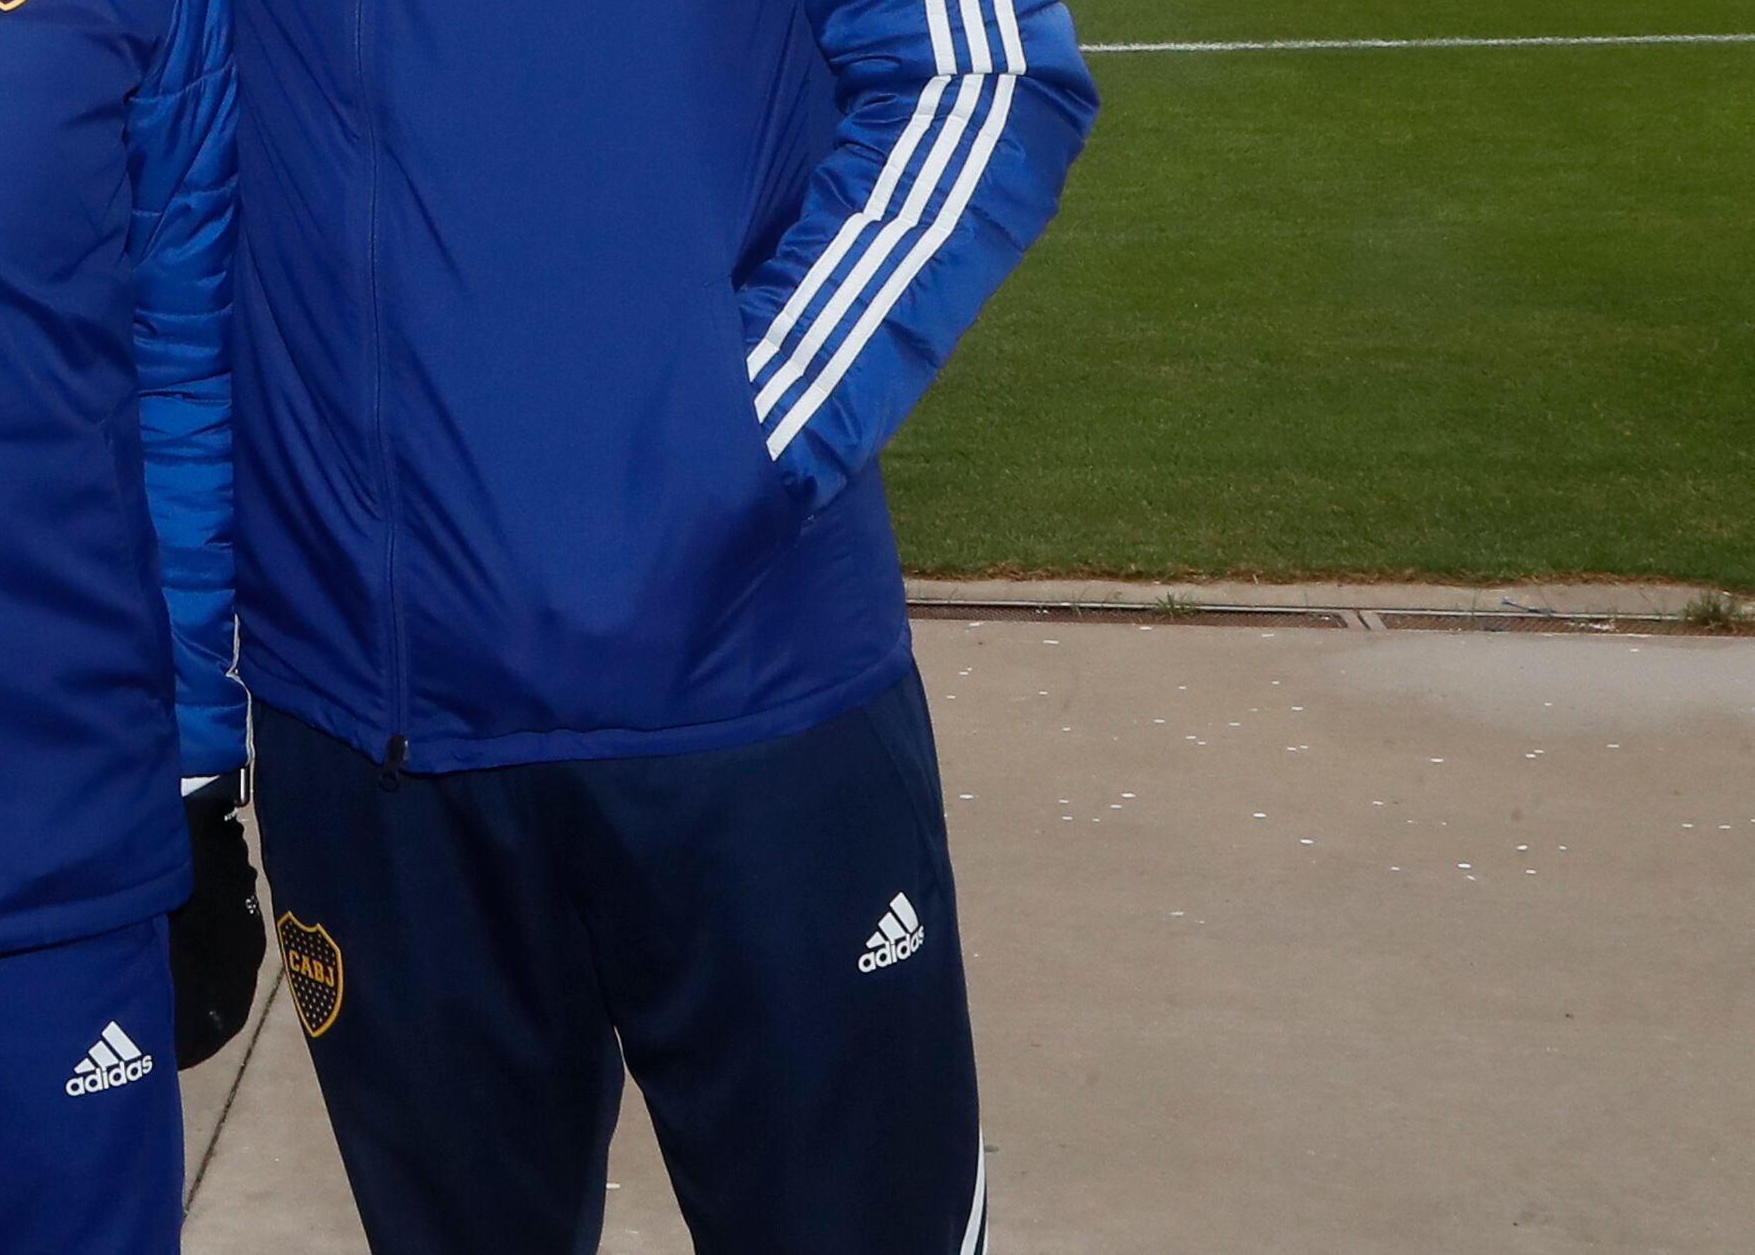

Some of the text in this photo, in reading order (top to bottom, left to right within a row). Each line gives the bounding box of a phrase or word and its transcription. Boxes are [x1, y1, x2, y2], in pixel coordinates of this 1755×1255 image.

[289, 949, 335, 988] CABJ
[858, 926, 924, 973] adidas
[65, 1055, 153, 1096] adidas
